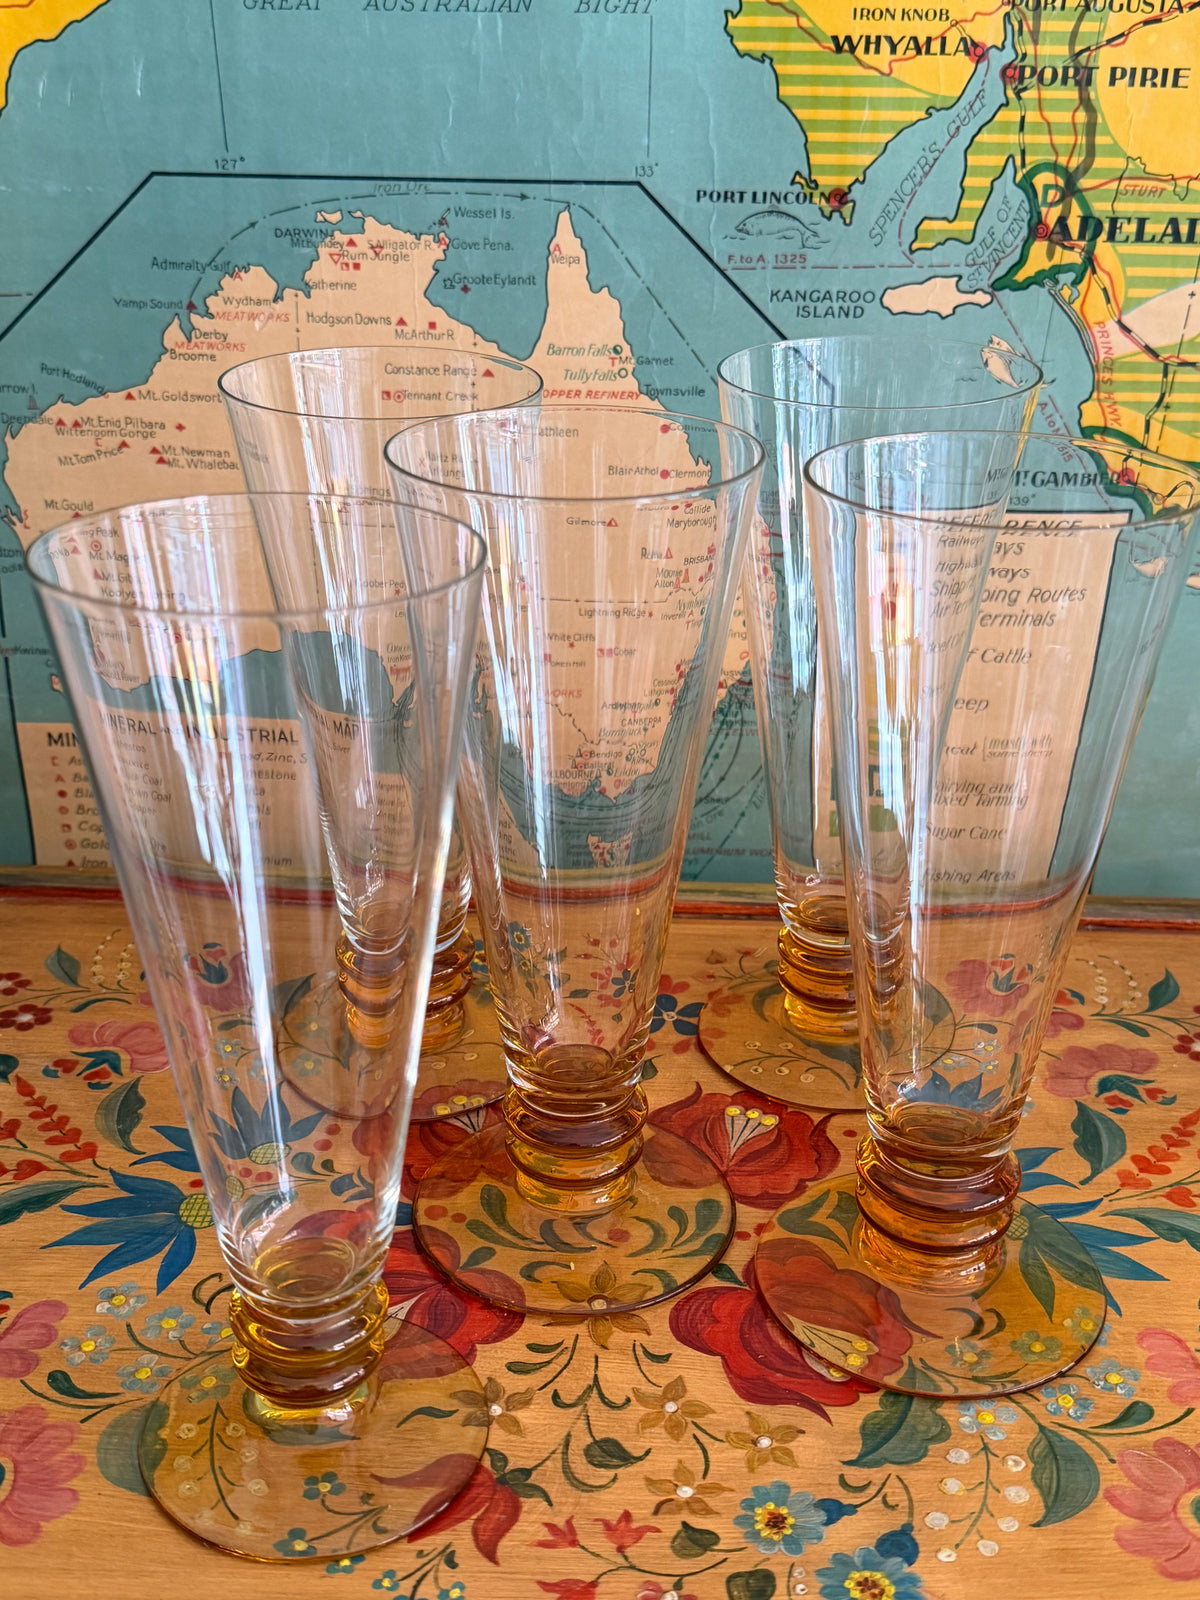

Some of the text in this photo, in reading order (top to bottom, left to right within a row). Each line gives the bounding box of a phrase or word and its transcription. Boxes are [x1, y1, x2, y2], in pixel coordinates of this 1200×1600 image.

[574, 0, 657, 14] BIGHT
[1074, 0, 1185, 14] AUGUSTA
[853, 7, 950, 22] IRON KNOB
[830, 35, 971, 56] WHYALLA
[1017, 65, 1191, 88] PORT PIRIE
[1119, 183, 1167, 198] STURT
[696, 190, 832, 205] PORT LINCOLN
[454, 207, 496, 219] Wessel
[274, 227, 329, 239] DARWIN
[965, 196, 1016, 266] GULF OF
[452, 239, 479, 250] Gove
[341, 250, 410, 264] Rum Jungle
[551, 254, 580, 267] Weipa
[739, 255, 752, 264] to
[774, 254, 807, 264] 1325
[151, 257, 207, 273] Admiralty
[304, 279, 357, 291] Katherine
[770, 290, 876, 304] KANGAROO
[149, 299, 183, 309] Sound
[214, 311, 290, 323] MEATWORKS
[354, 313, 391, 325] Downs
[796, 306, 865, 319] ISLAND
[194, 329, 228, 342] Derby
[174, 341, 246, 352] MEATWORKS
[547, 343, 612, 357] Barron Falls
[169, 350, 216, 362] Broome
[637, 356, 674, 366] Garnet
[384, 363, 440, 376] Constance
[403, 389, 441, 401] Tennant
[585, 389, 641, 400] REFINERY
[644, 384, 706, 397] Townsville
[119, 428, 156, 439] Gorge
[539, 426, 579, 438] athleen
[608, 465, 659, 476] Blair Athol
[669, 467, 711, 478] Clermont
[566, 516, 607, 526] Gilmore
[1026, 586, 1087, 604] Routes
[981, 647, 1032, 664] Cattle
